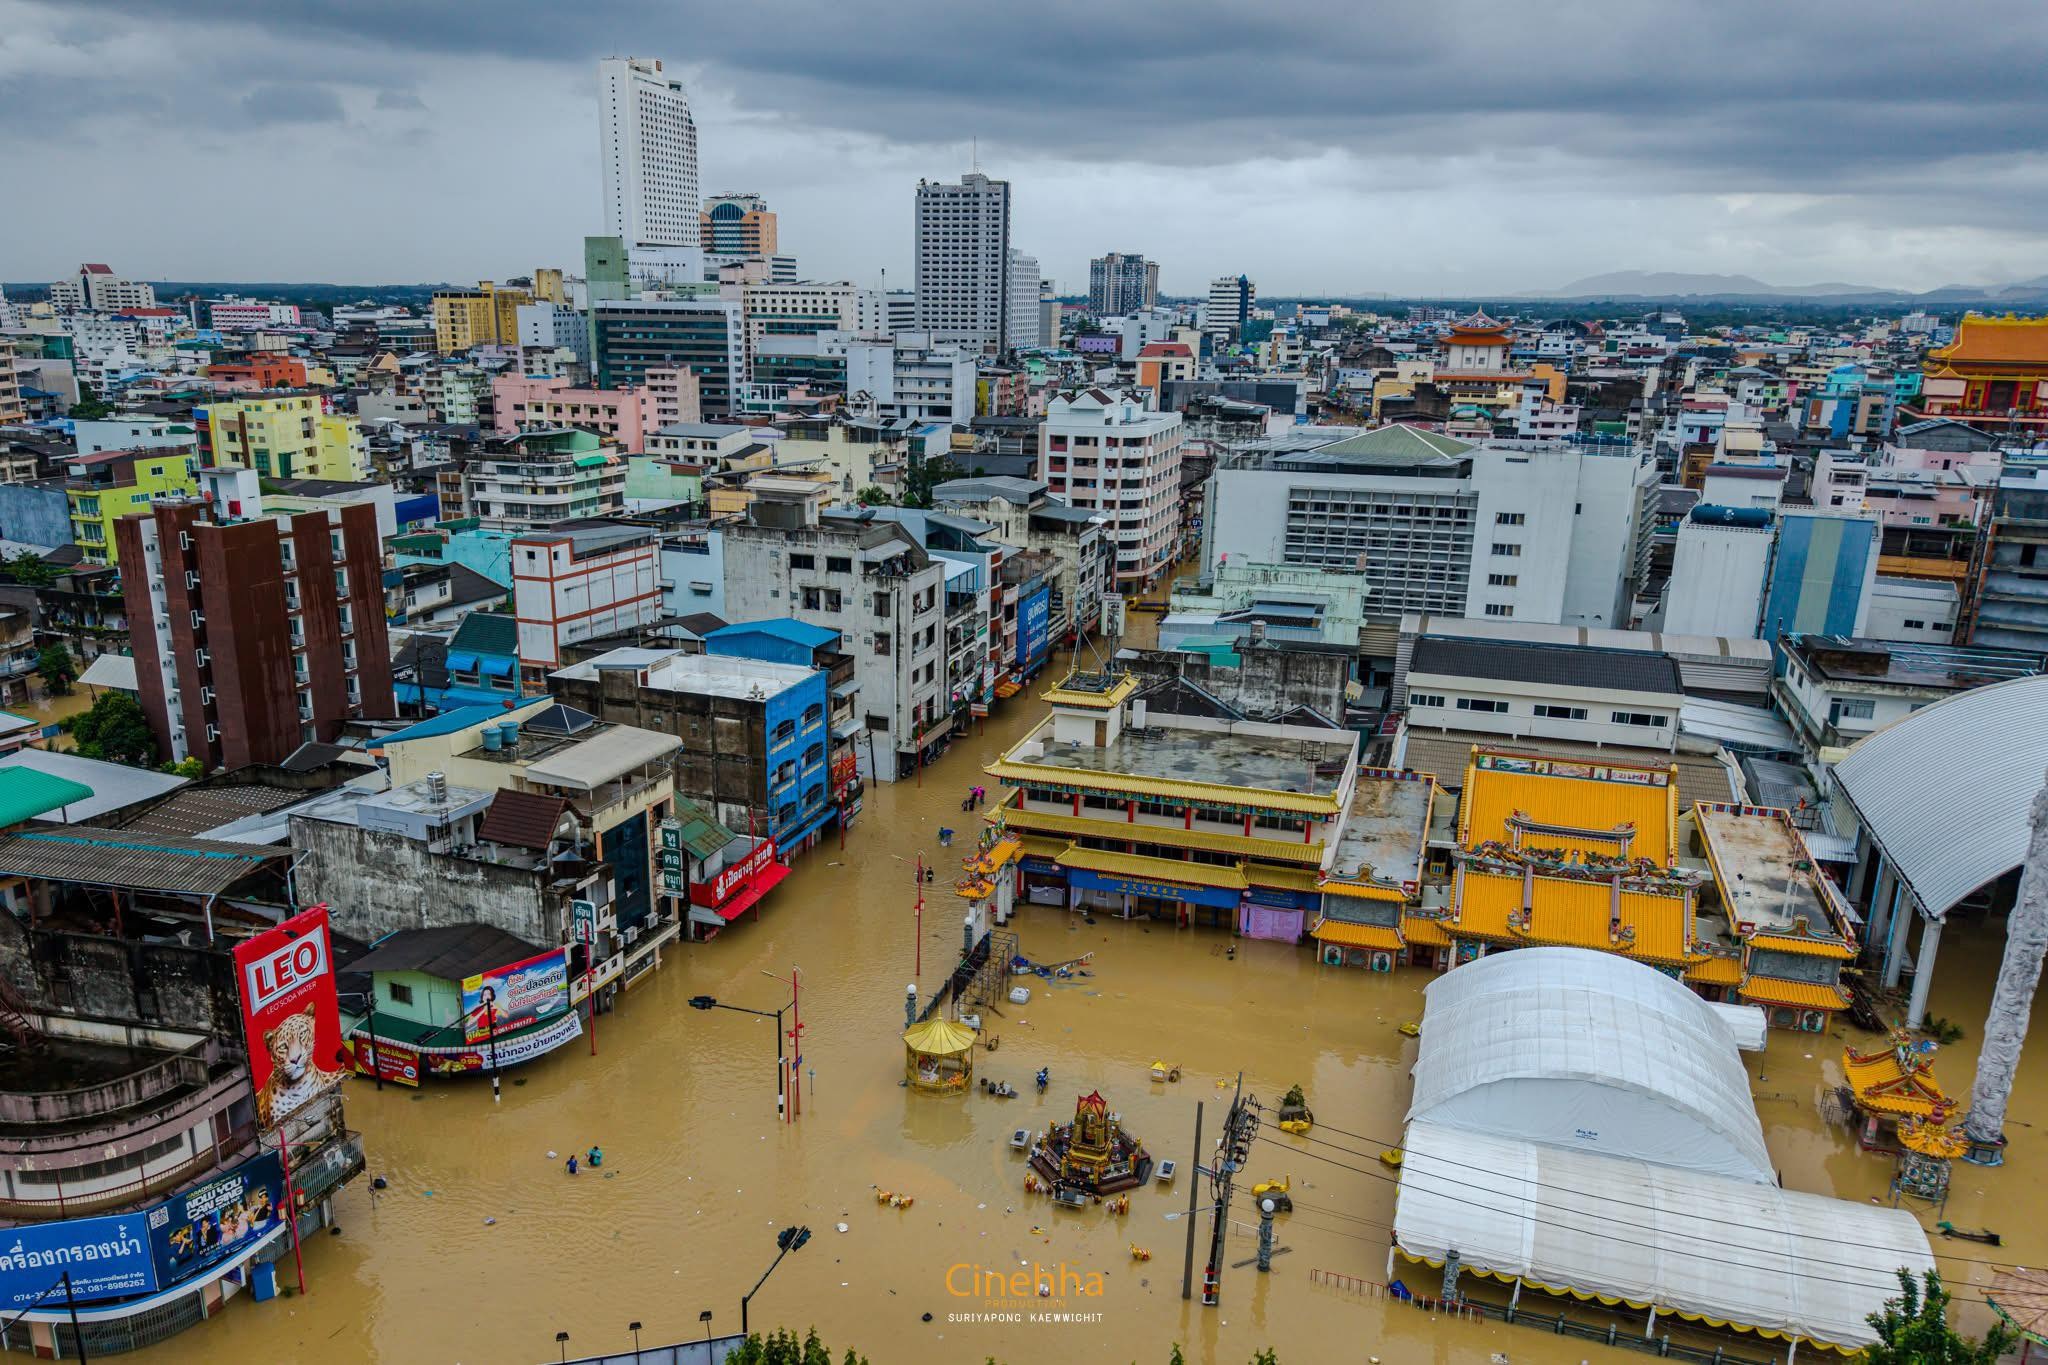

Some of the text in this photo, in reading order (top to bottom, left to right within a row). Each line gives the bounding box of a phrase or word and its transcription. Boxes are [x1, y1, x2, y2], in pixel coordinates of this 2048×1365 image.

[254, 941, 319, 1001] LEO
[297, 981, 317, 998] WATER
[186, 1190, 217, 1210] NOW
[216, 1176, 242, 1195] YOU
[187, 1185, 244, 1220] CAN SING
[88, 1279, 146, 1293] 081-8986262
